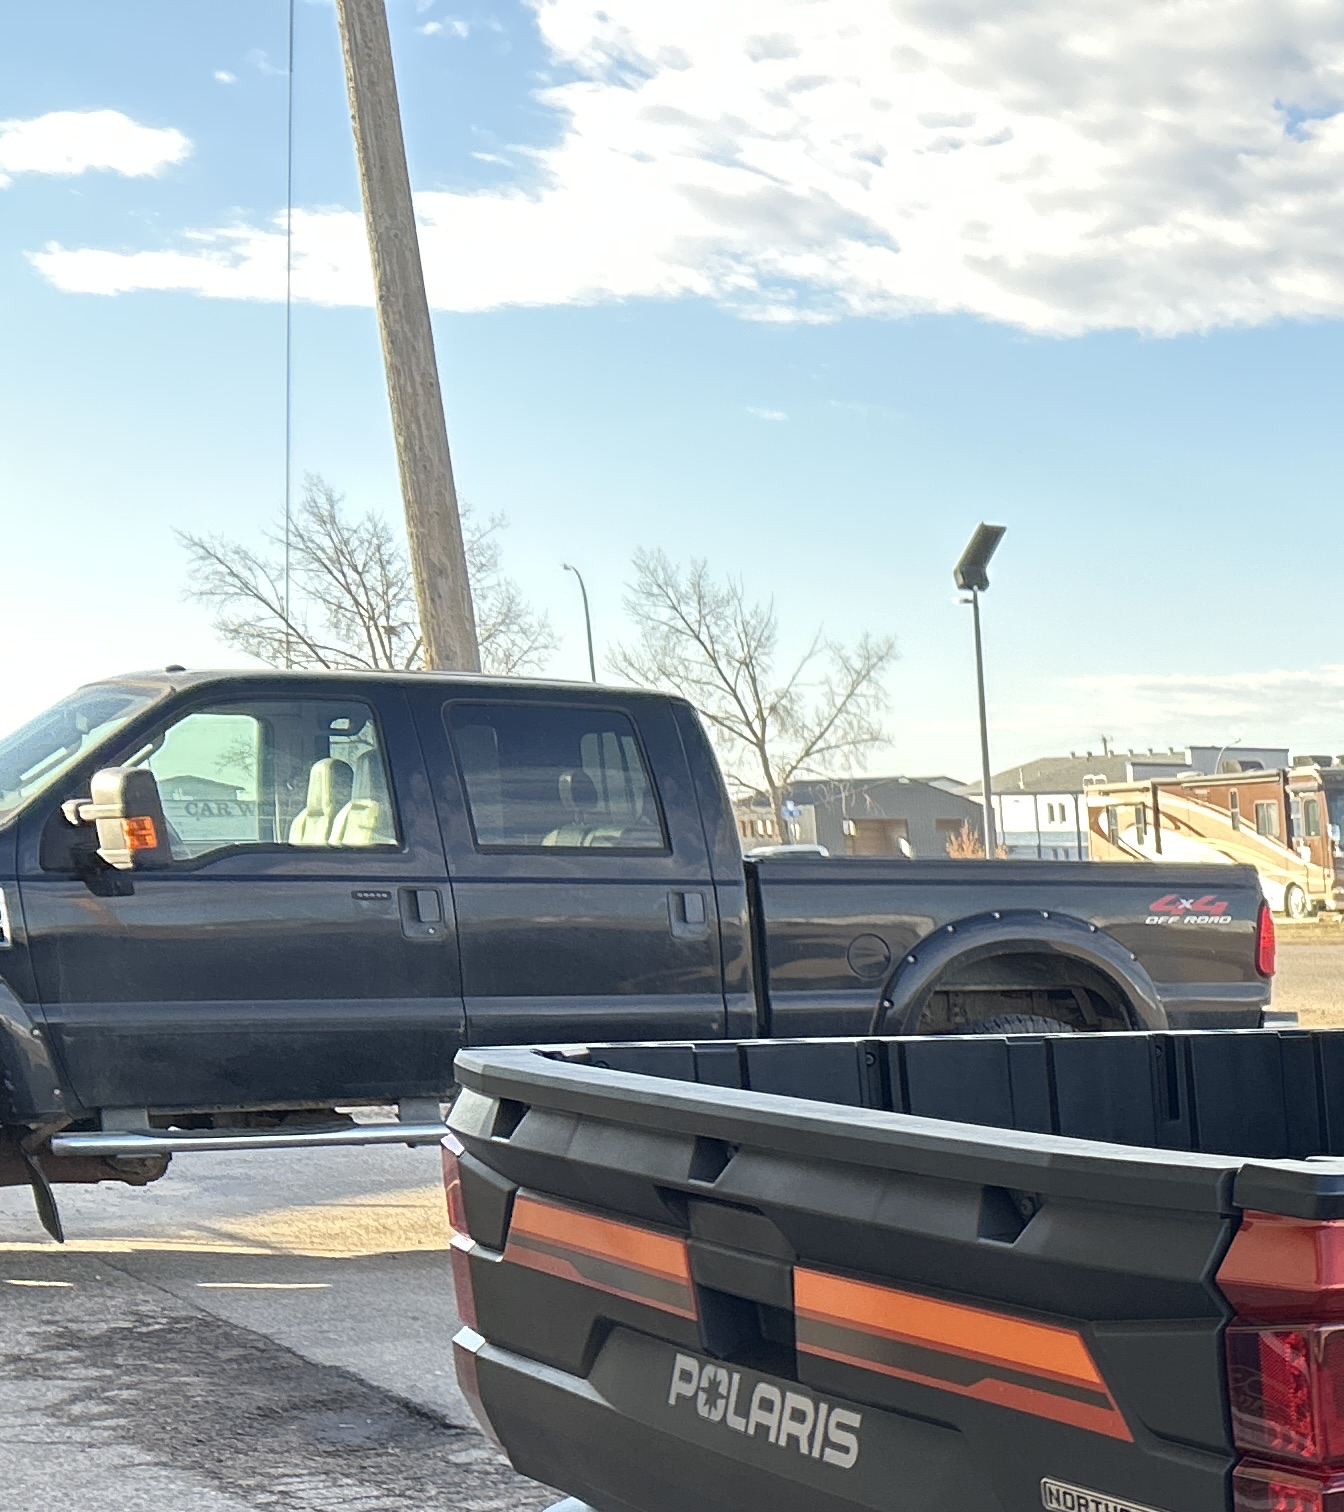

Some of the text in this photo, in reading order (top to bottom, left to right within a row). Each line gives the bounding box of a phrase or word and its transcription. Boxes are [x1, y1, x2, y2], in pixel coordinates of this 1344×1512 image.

[184, 802, 231, 817] CAR
[1145, 915, 1232, 925] OFF ROAD
[668, 1353, 862, 1469] POLARIS
